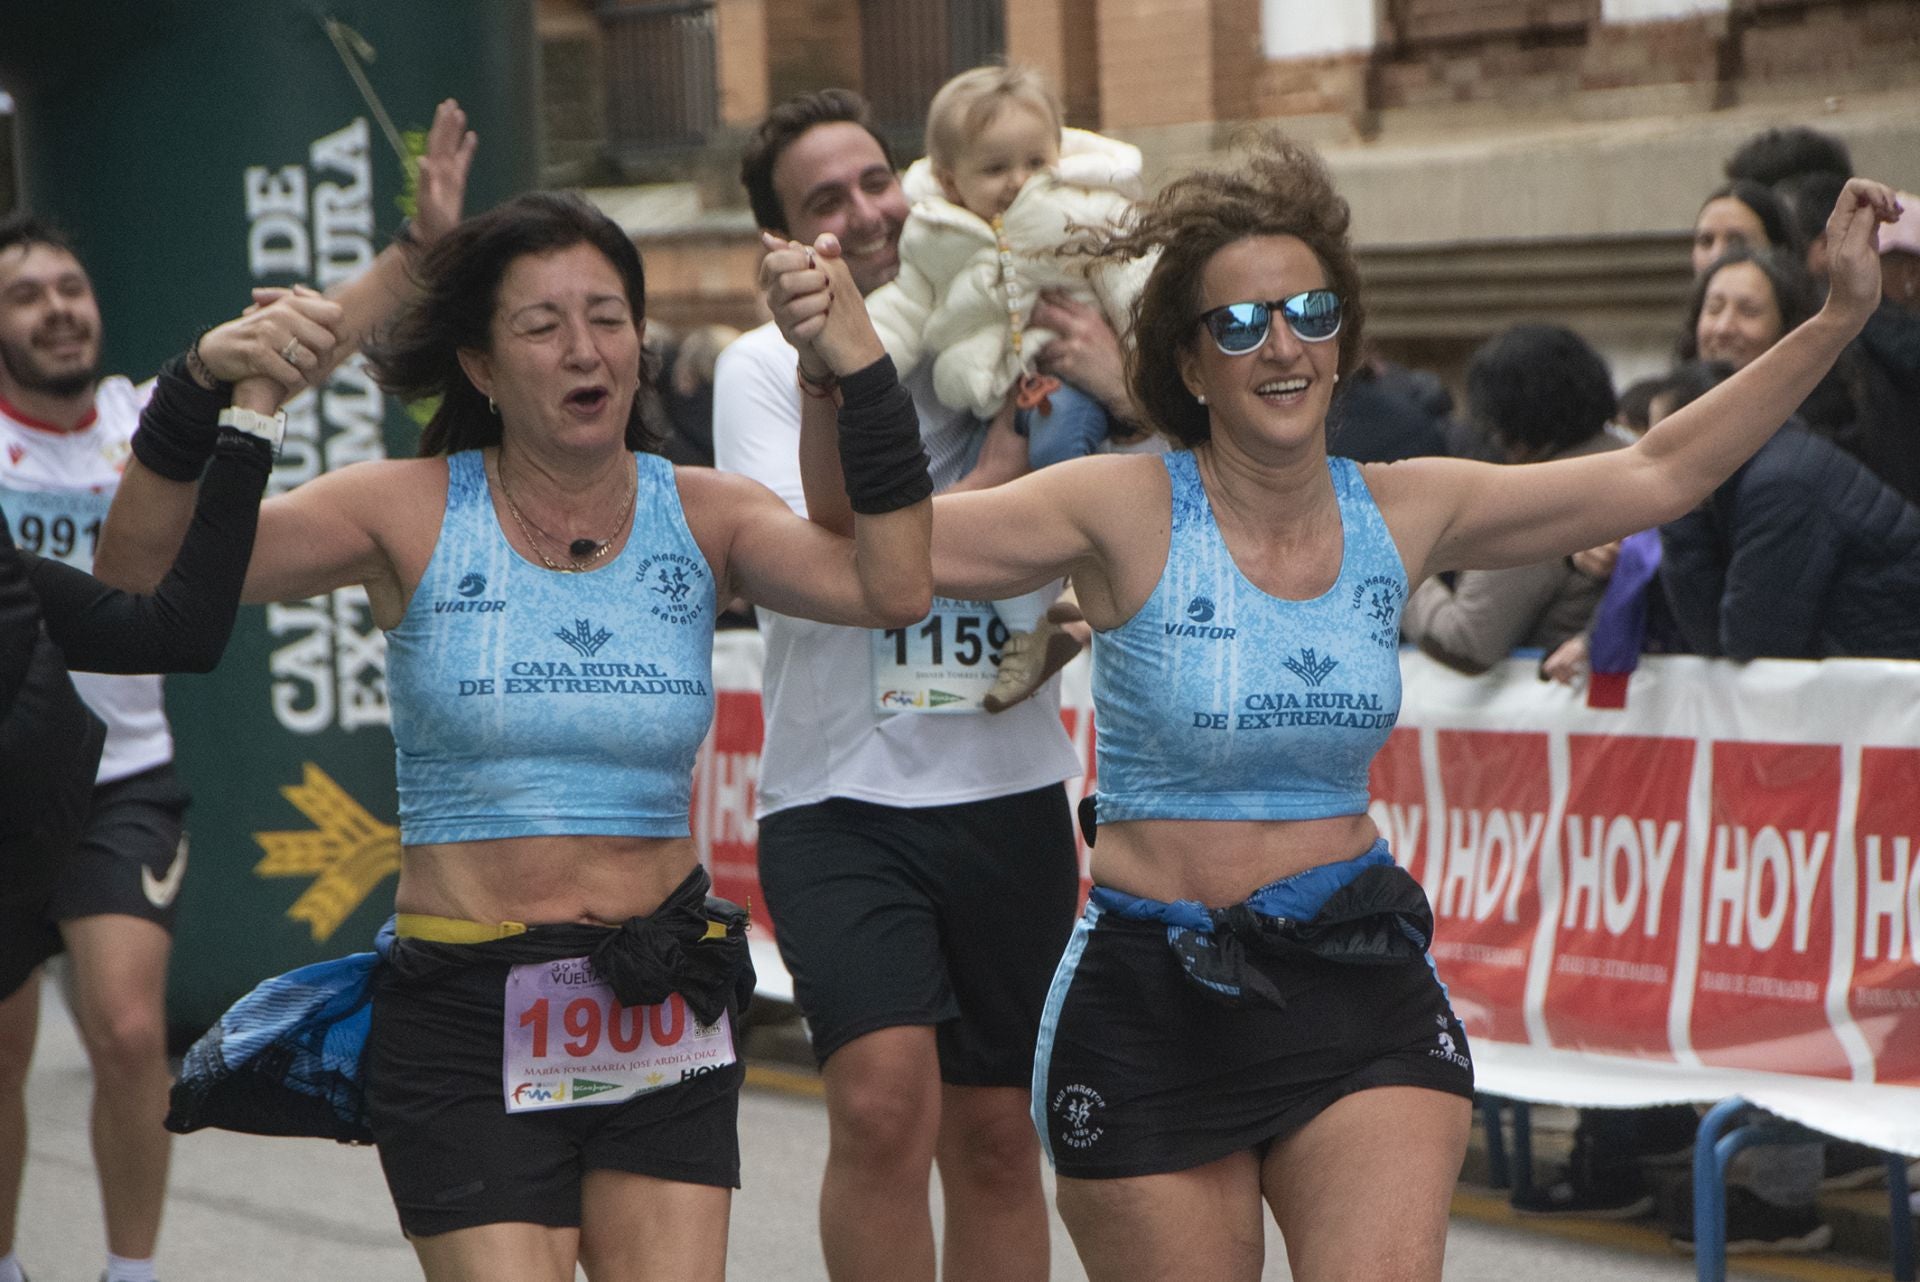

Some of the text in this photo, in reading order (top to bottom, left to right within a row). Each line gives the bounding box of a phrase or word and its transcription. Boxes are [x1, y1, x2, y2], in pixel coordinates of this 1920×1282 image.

[244, 165, 336, 733] CAJ DE
[635, 553, 705, 583] CLUB MARATON
[434, 600, 507, 613] VIATOR
[1352, 584, 1366, 609] CLUB
[651, 603, 704, 625] BADAJOZ
[884, 614, 1011, 667] 1159
[1164, 622, 1237, 640] VIATOR
[511, 661, 667, 679] CAJA RURAL
[458, 678, 708, 697] DE EXTREMADURA
[1245, 692, 1383, 711] CAJA RURAL
[1193, 711, 1395, 729] DE EXTREMADUR
[1440, 807, 1545, 923] HOY
[1563, 813, 1683, 937] HOY
[1705, 825, 1830, 953] HOY
[519, 991, 686, 1058] 1900
[1066, 1083, 1106, 1108] MARATON
[1062, 1127, 1104, 1148] BADAJOZ
